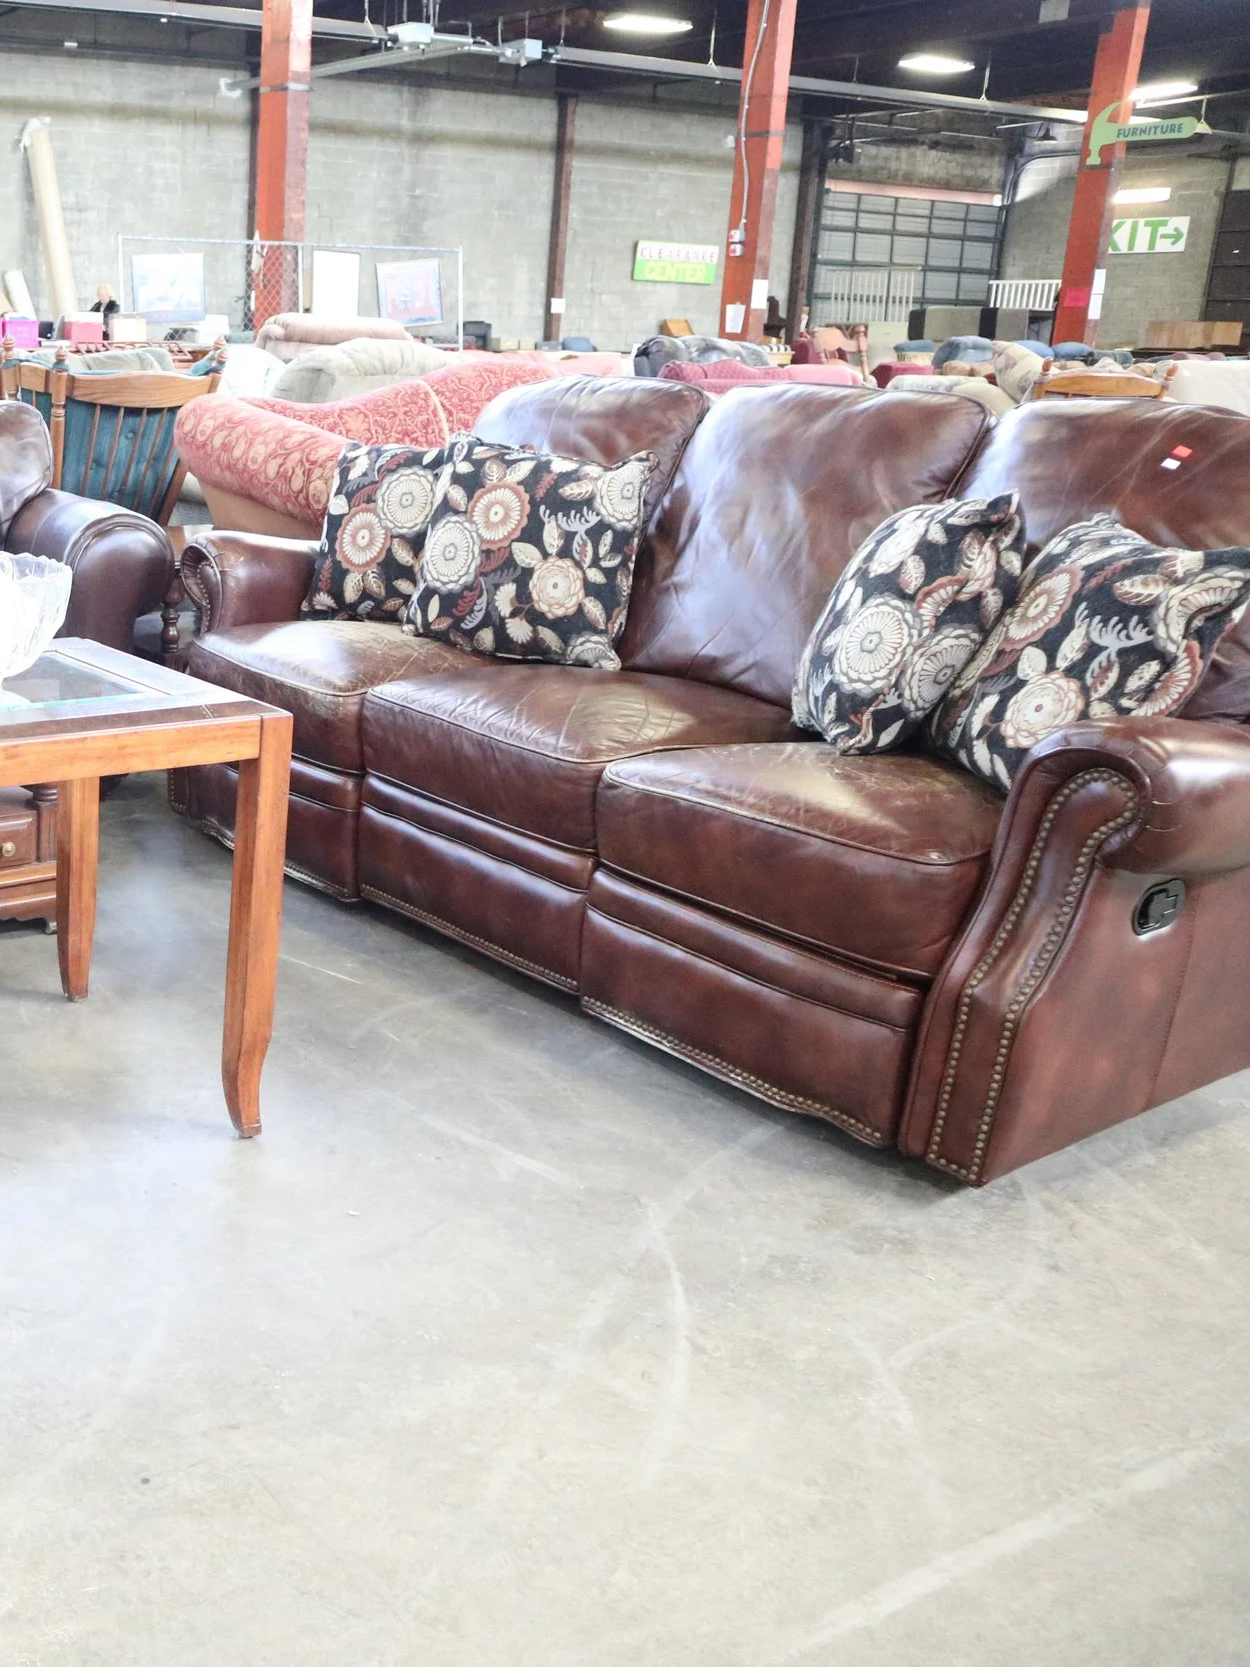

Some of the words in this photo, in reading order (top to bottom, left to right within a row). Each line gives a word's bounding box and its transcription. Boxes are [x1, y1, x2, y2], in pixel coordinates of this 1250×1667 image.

[1116, 123, 1184, 138] FURNITURE
[640, 246, 715, 262] CLEARANCE
[645, 260, 707, 283] CENTER
